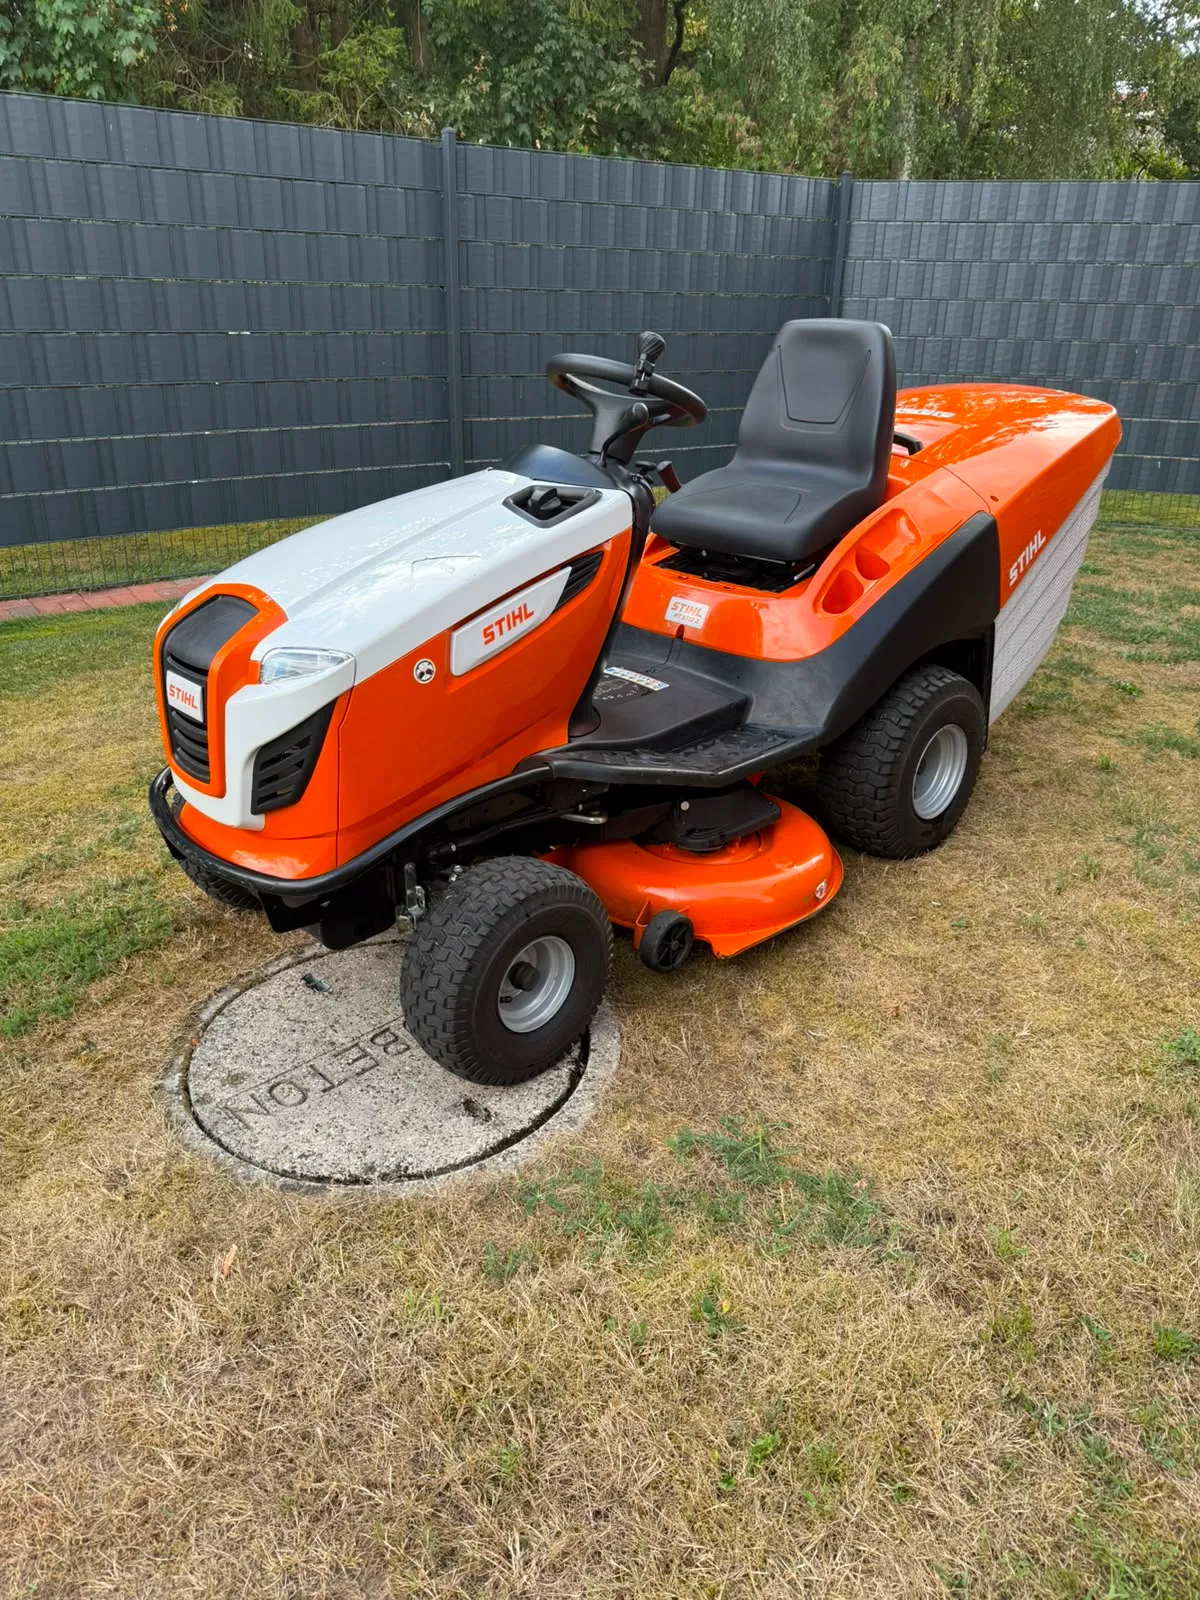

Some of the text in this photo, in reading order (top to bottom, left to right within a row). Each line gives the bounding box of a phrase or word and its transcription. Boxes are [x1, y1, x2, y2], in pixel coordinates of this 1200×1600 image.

[1009, 529, 1046, 587] STIHL
[482, 603, 534, 646] STIHL
[671, 601, 702, 617] STIHL
[169, 683, 198, 710] STIHL
[222, 1027, 411, 1131] BETON
